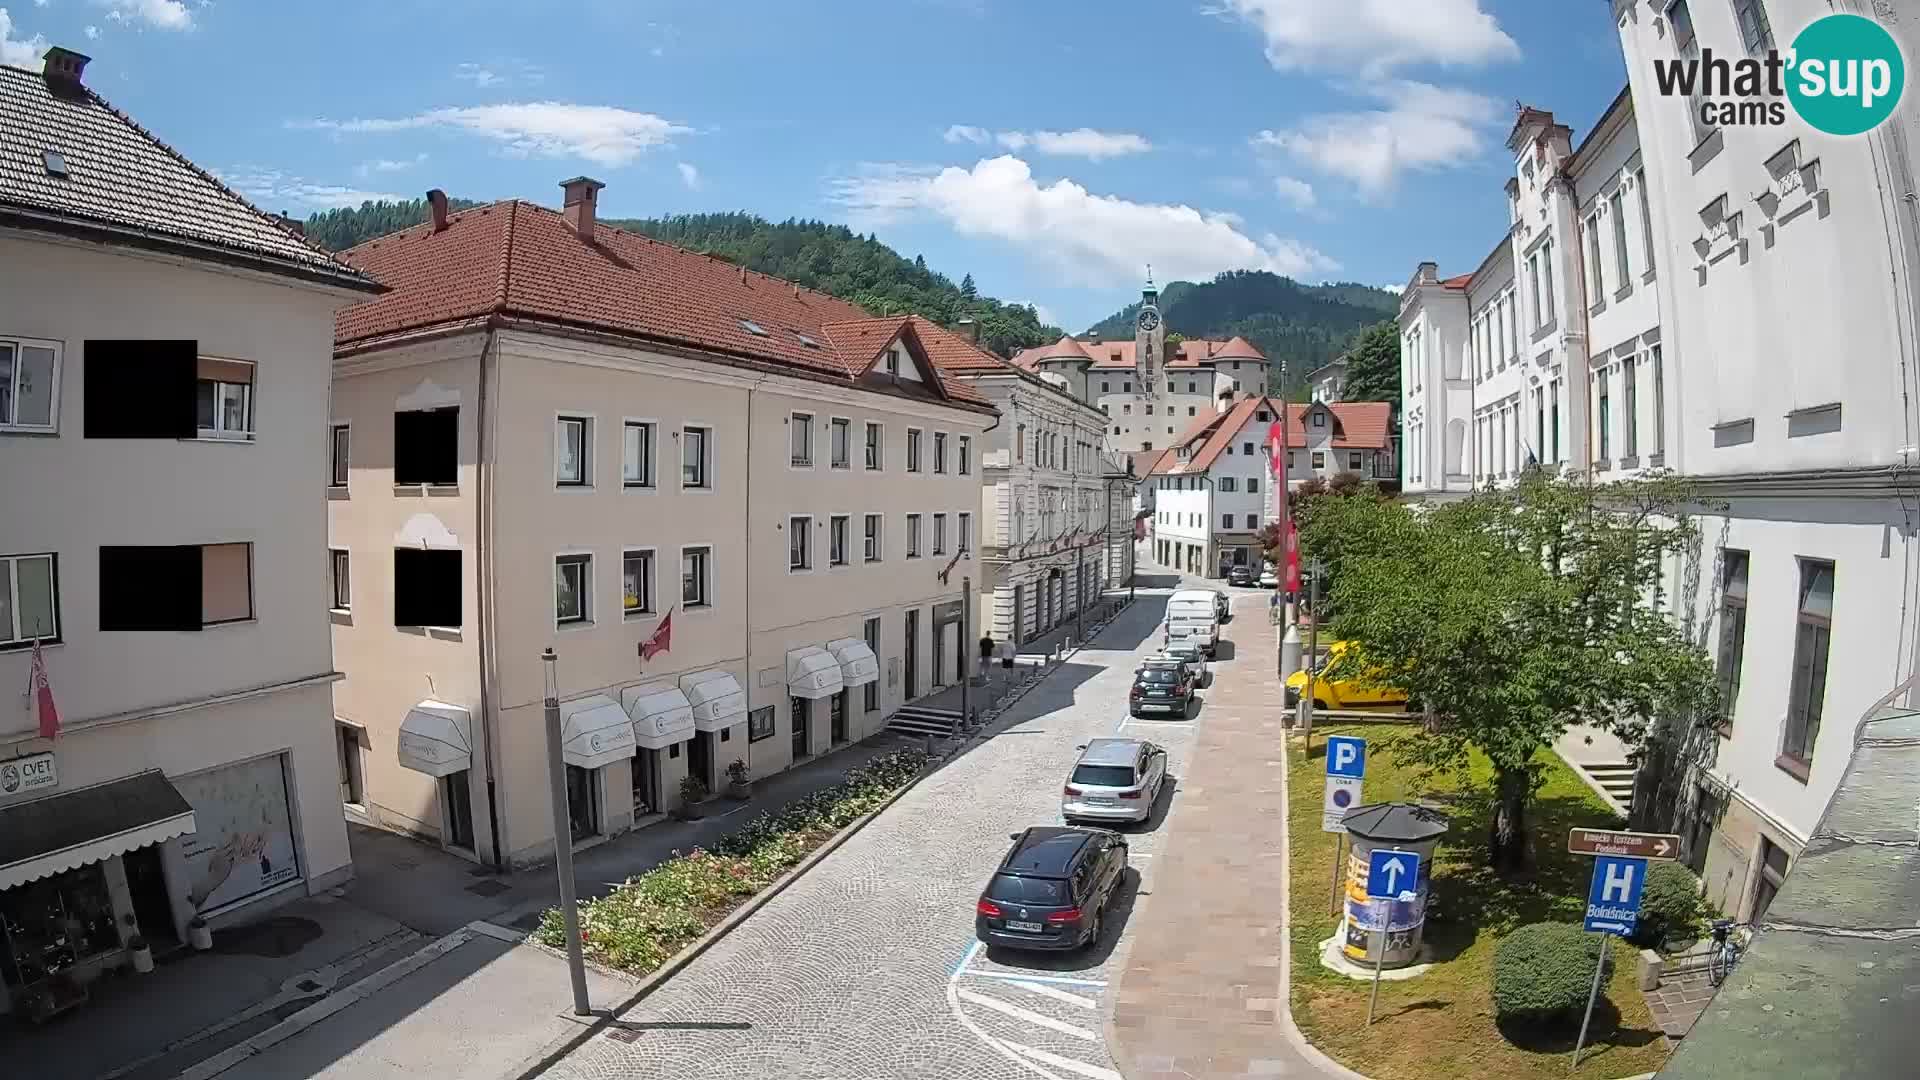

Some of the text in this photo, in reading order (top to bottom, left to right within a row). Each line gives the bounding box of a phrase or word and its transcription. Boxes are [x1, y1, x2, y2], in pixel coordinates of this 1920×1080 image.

[23, 760, 50, 776] CVET
[1335, 742, 1357, 770] P
[1602, 863, 1634, 903] H
